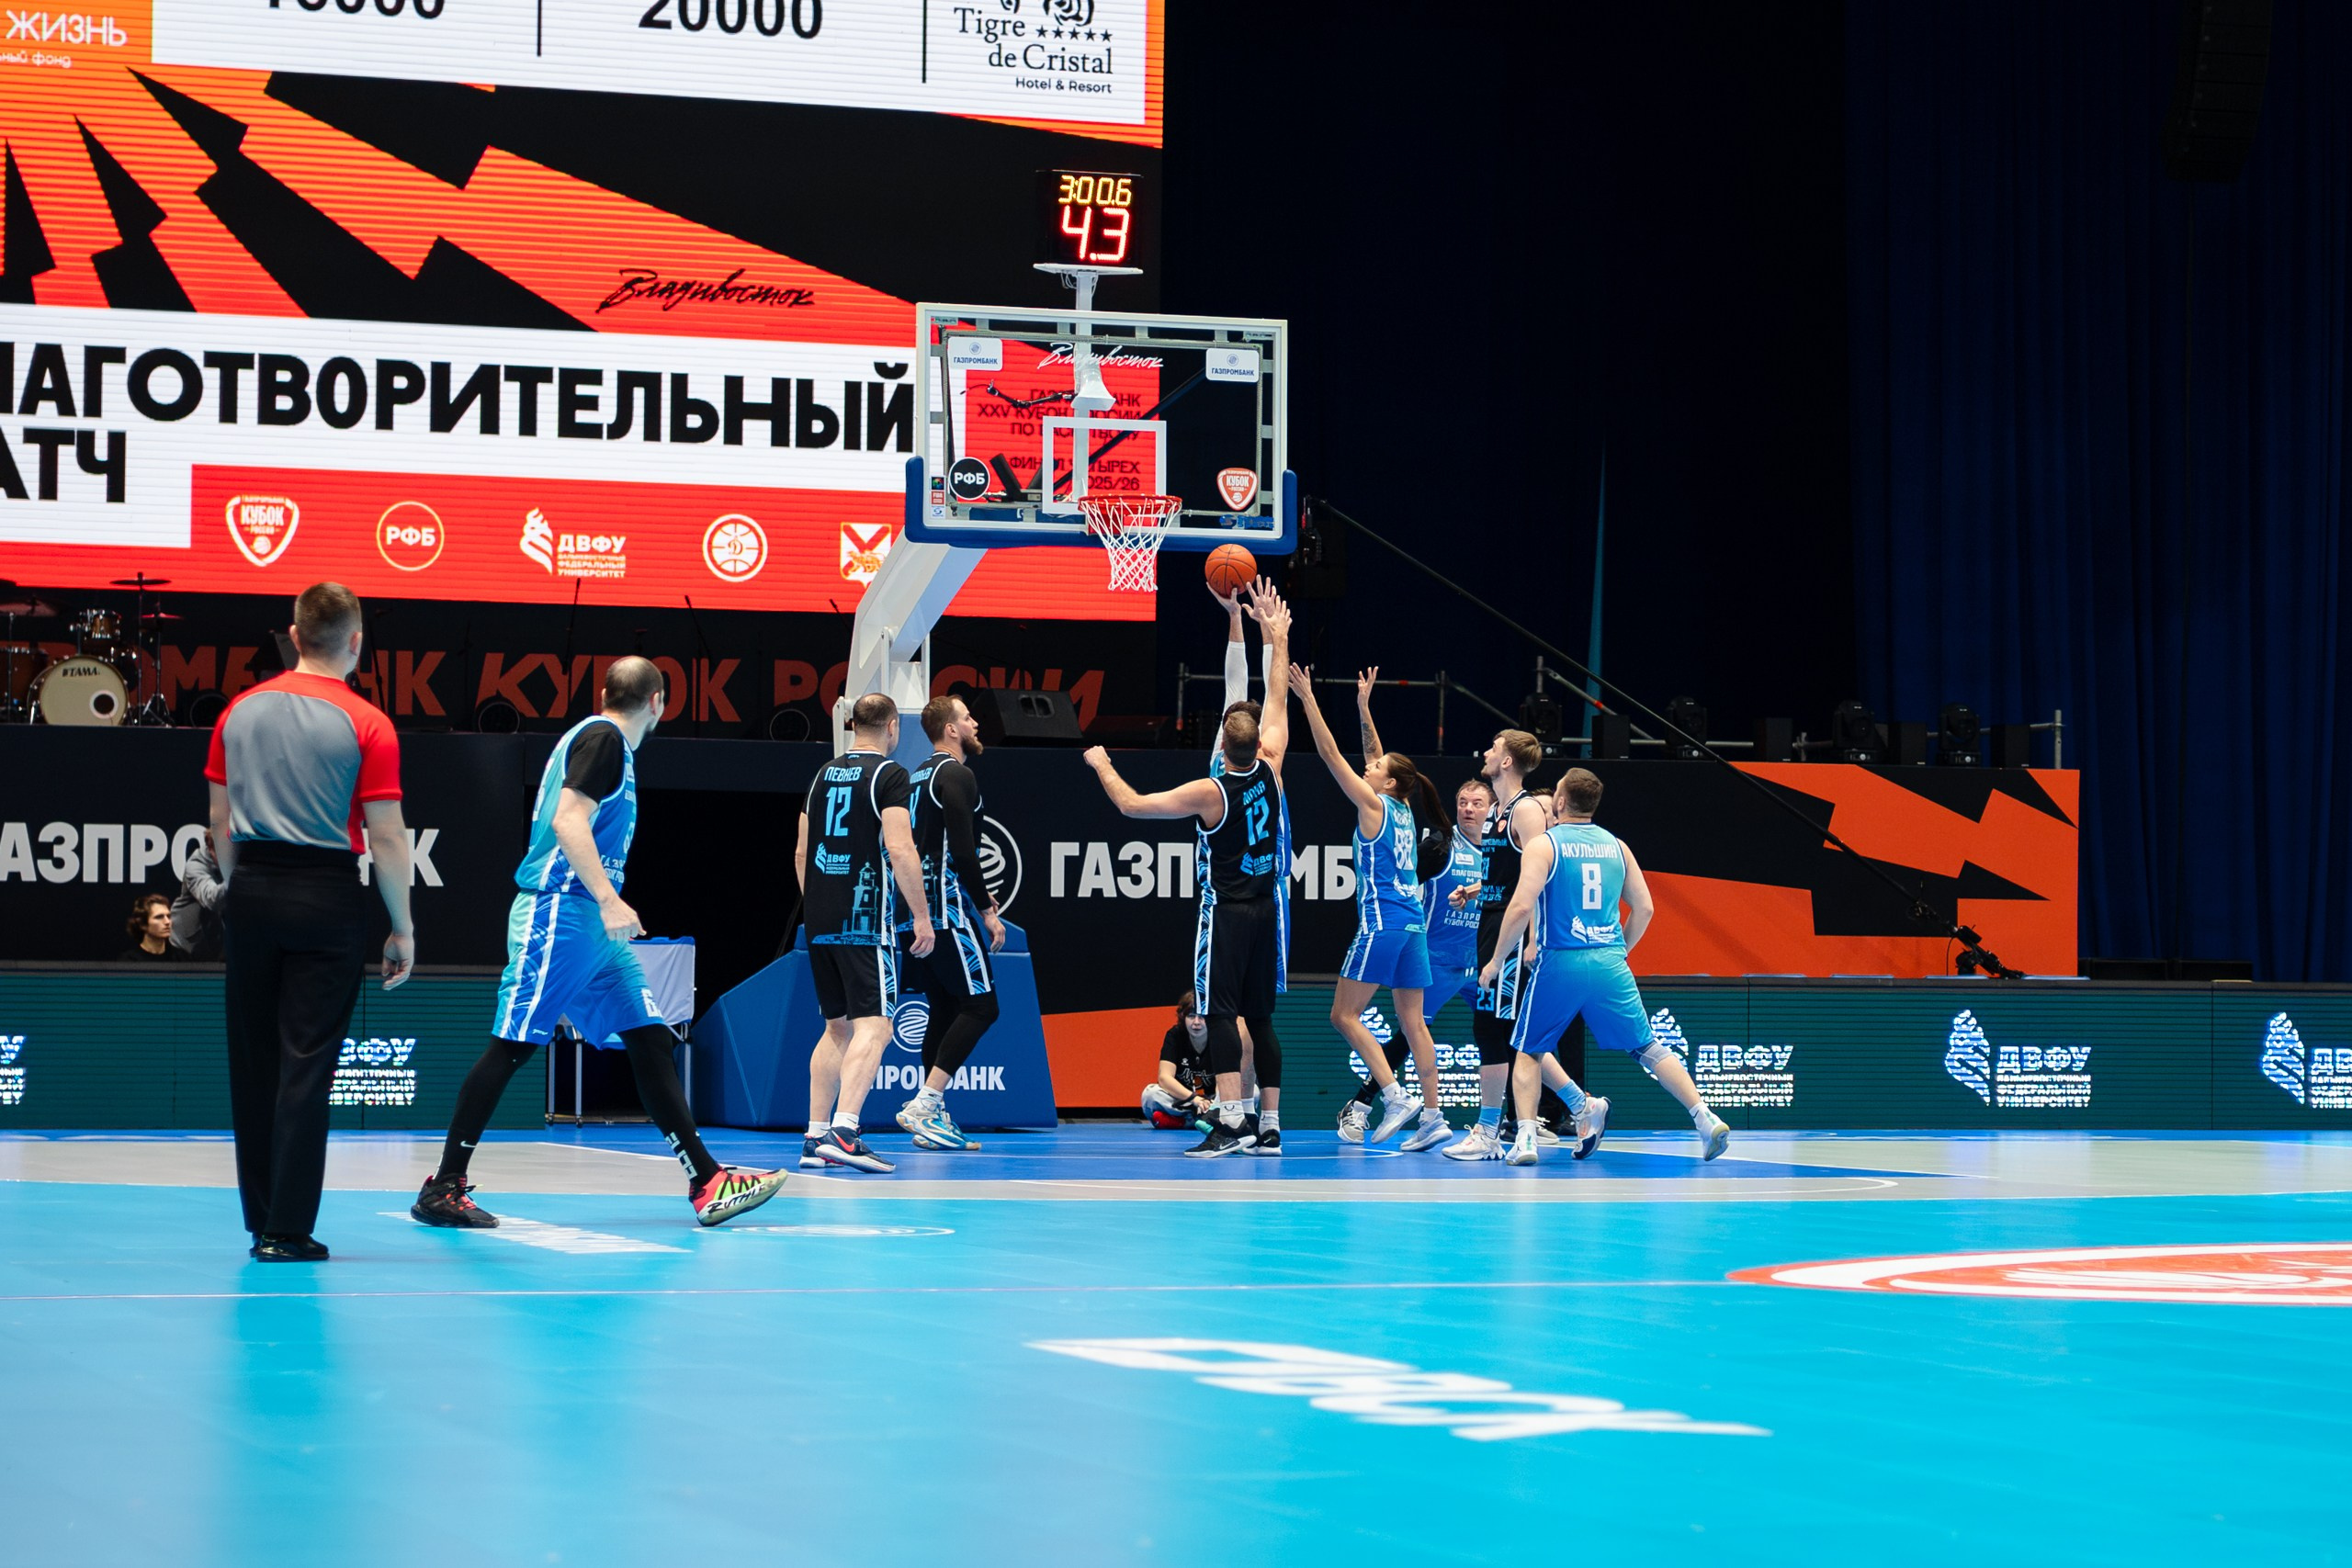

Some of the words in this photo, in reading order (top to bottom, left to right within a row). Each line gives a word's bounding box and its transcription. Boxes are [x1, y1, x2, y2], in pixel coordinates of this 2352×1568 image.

[6, 9, 128, 46] ЖИЗНЬ
[954, 7, 1025, 43] Tigre
[989, 43, 1017, 68] de
[1023, 44, 1114, 74] Cristal
[1015, 77, 1051, 89] Hotel
[1056, 81, 1064, 90] &
[1069, 81, 1112, 93] Resort
[596, 268, 816, 313] Владивосток
[954, 356, 998, 365] ГАЗПРОМБАНК
[1037, 343, 1164, 369] Вливосток
[1211, 367, 1255, 376] ГАЗПРОМБАНК
[1012, 423, 1035, 436] ПО
[1010, 457, 1065, 471] ФИНЛ
[955, 472, 986, 485] РФБ
[1088, 475, 1140, 491] 025/26
[1227, 475, 1250, 486] КУБОК
[241, 504, 285, 526] КУБОК
[386, 526, 436, 547] РФБ
[557, 534, 627, 554] ДВФУ
[557, 569, 626, 578] УНИВЕРСИТЕТ
[824, 766, 863, 783] ПЕВНЕВ
[825, 786, 853, 836] 12
[1246, 796, 1270, 846] 12
[827, 854, 851, 863] ДВФУ
[1561, 842, 1617, 859] АКУЛЬШИН
[1581, 863, 1602, 909] 8
[1445, 910, 1481, 920] ГАЗПРО
[1476, 987, 1495, 1011] 23
[1695, 1045, 1793, 1073] ДВФУ
[1996, 1046, 2091, 1073] ДВФУ
